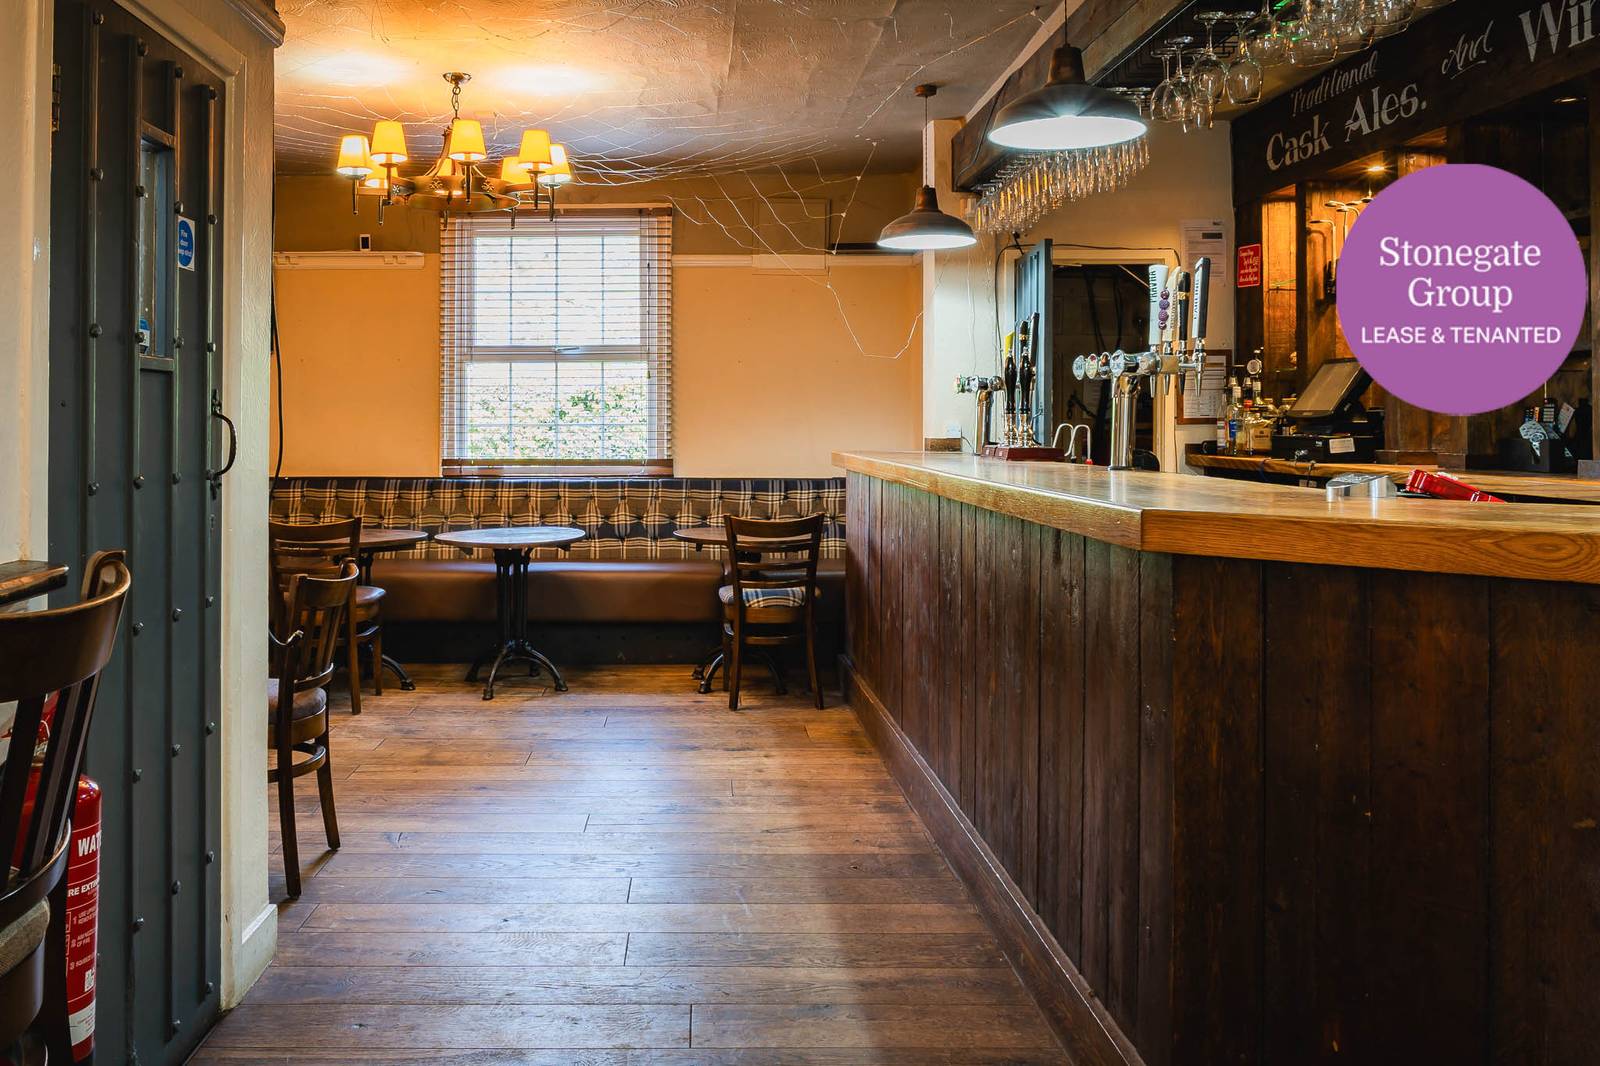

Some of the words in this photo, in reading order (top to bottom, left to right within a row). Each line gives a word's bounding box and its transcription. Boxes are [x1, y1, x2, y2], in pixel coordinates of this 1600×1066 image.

[1266, 114, 1333, 171] Cask
[1345, 83, 1427, 142] Ales.
[1442, 20, 1494, 75] And
